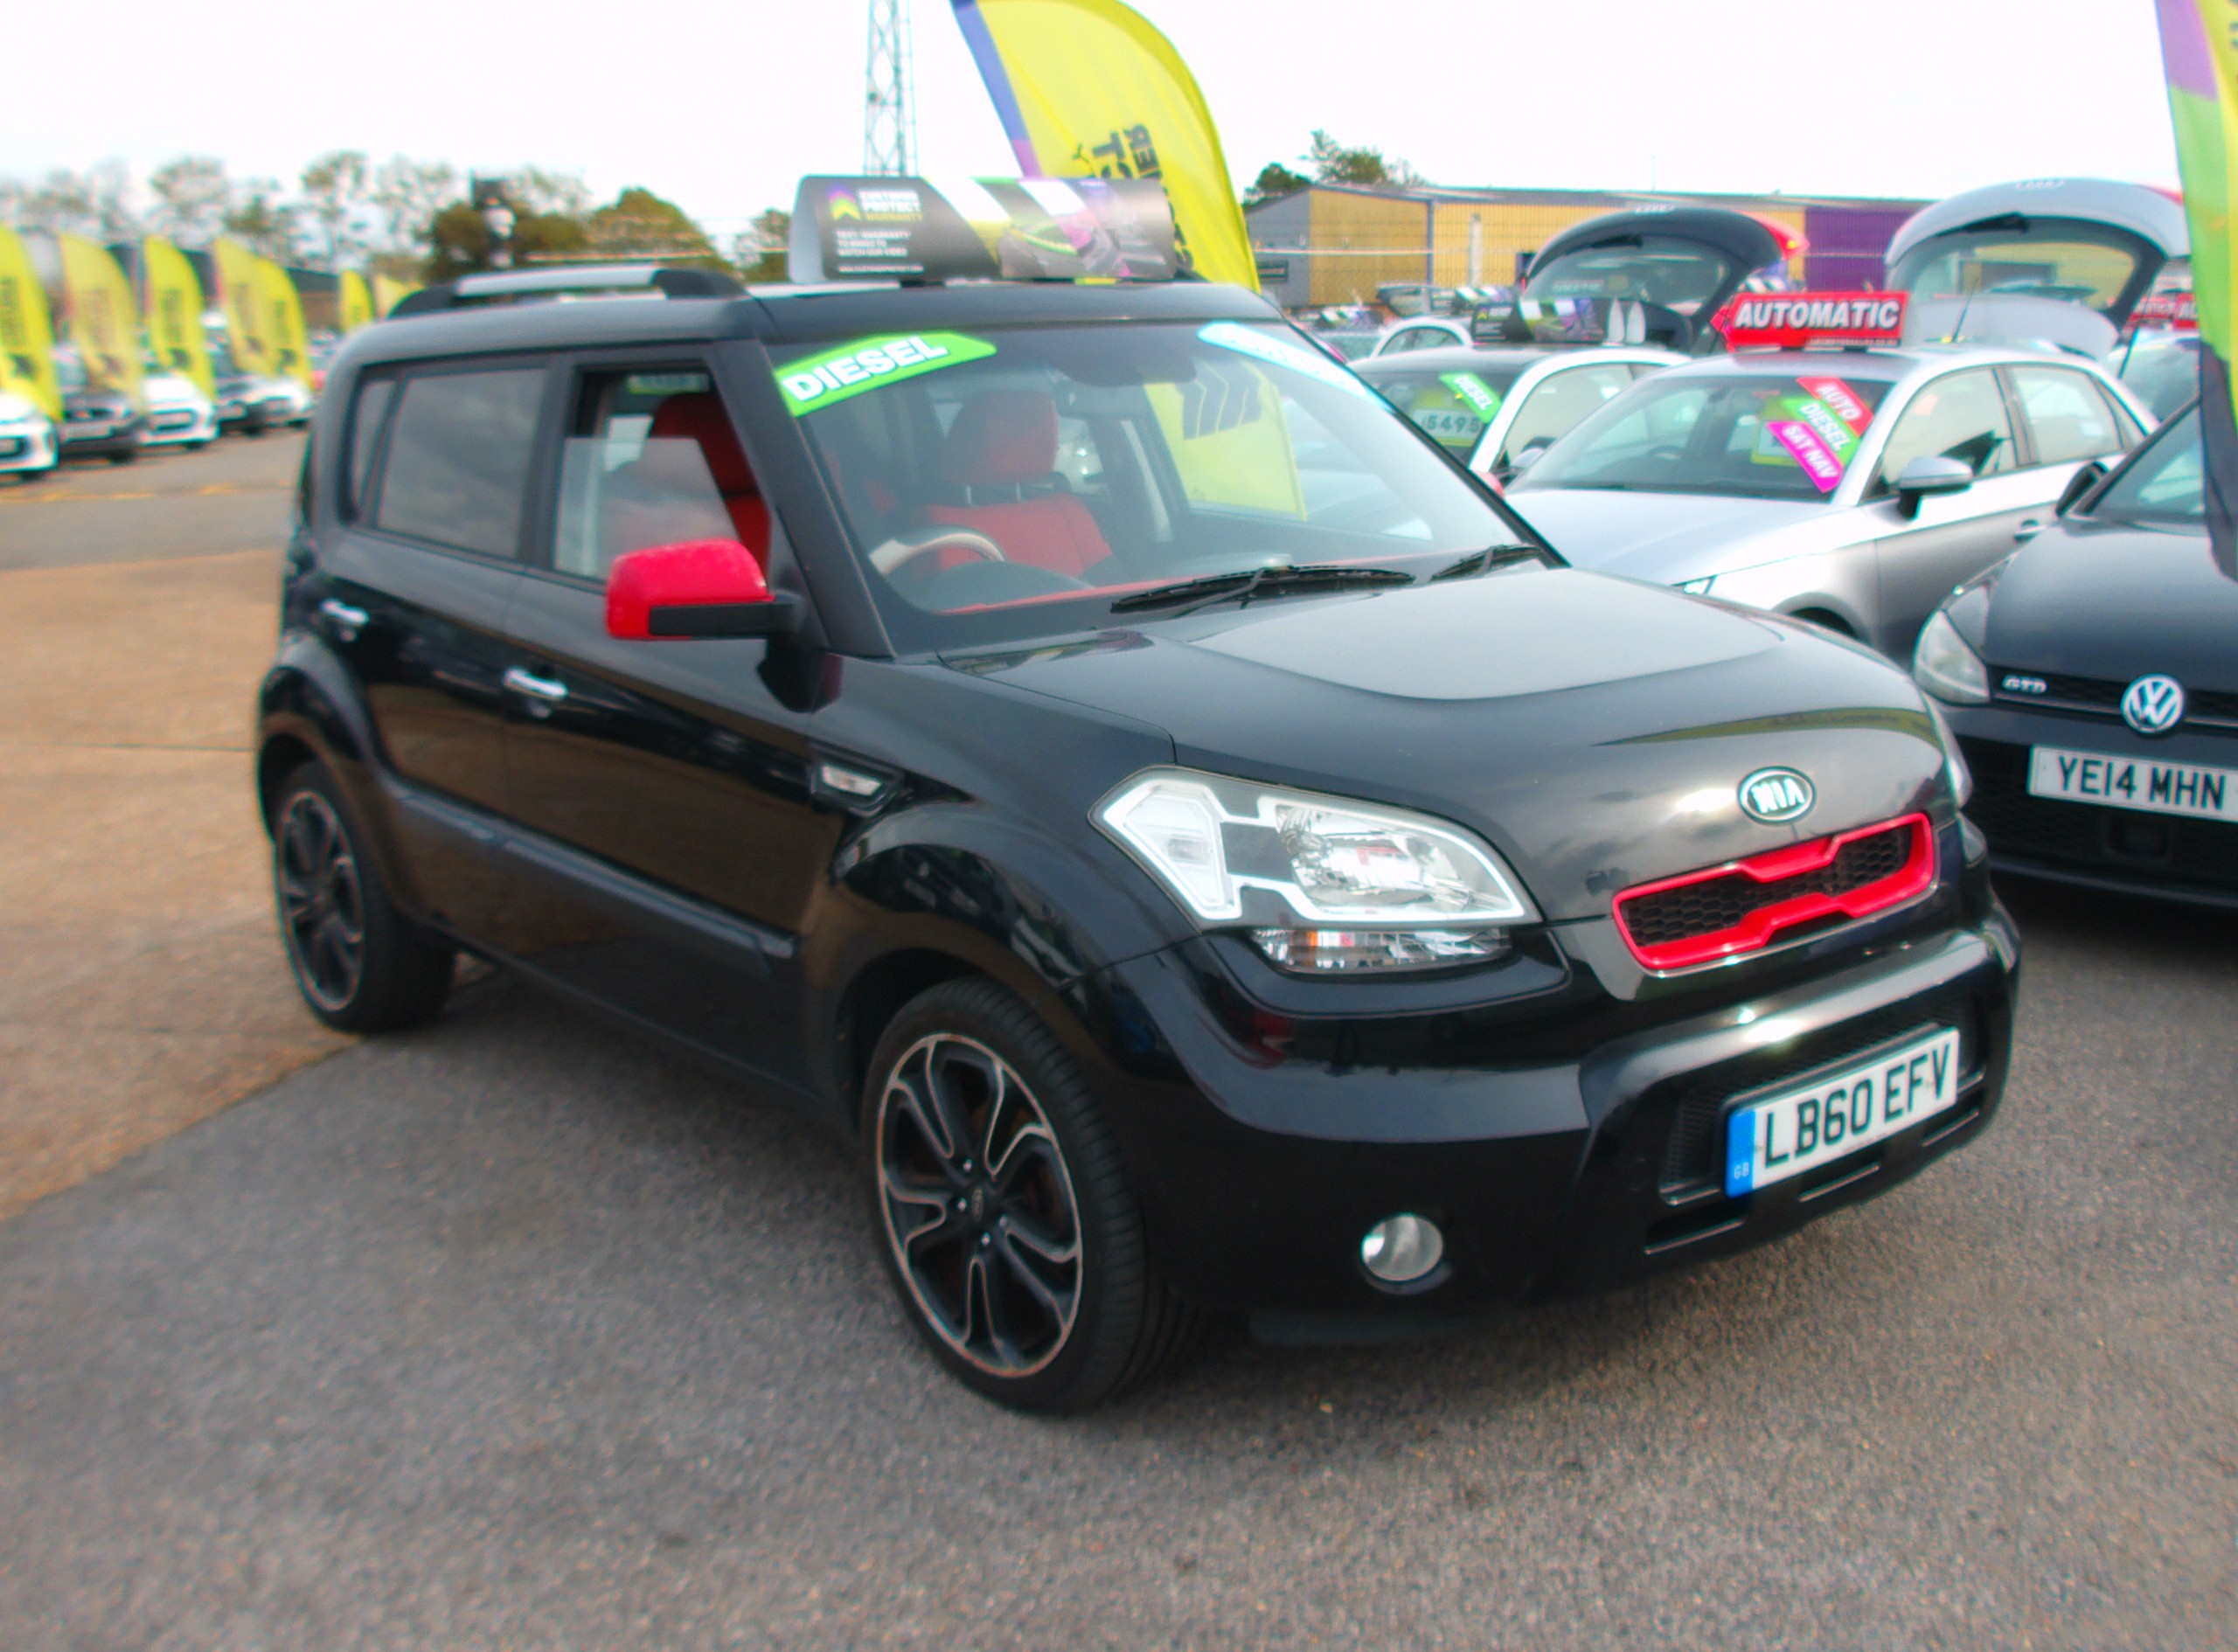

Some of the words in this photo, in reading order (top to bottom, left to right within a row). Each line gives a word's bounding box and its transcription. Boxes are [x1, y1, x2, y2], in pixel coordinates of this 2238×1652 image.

[1734, 299, 1901, 329] AUTOMATIC
[781, 335, 949, 401] DIESEL
[1800, 403, 1851, 451] DIESEL
[1817, 383, 1862, 420] AUTO
[1782, 426, 1815, 450] SAT
[1804, 450, 1839, 478] NAV
[2059, 755, 2137, 799] YE14
[2149, 767, 2226, 811] MHN
[1764, 1079, 1873, 1169] LB60
[1884, 1044, 1950, 1123] EFV
